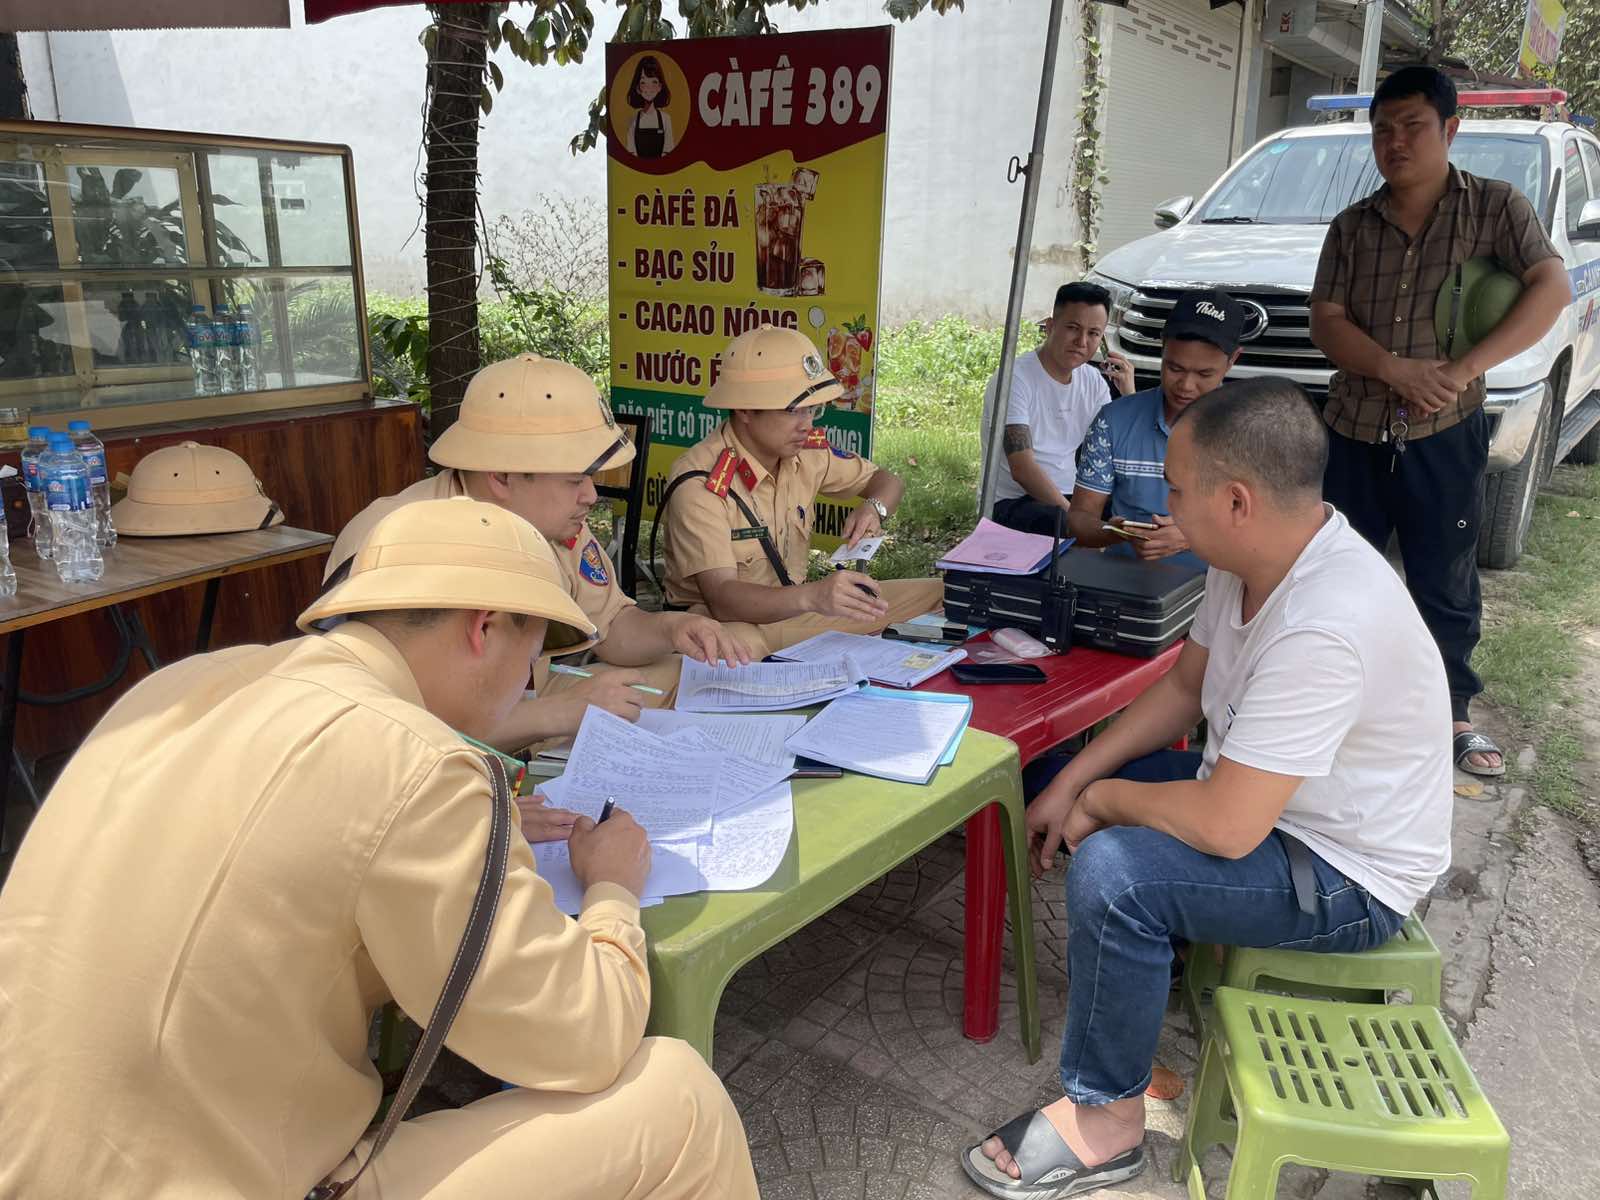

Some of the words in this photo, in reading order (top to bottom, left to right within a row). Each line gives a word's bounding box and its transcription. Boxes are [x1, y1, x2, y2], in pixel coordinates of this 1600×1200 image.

[698, 54, 795, 127] CÀFÊ
[805, 64, 882, 126] 389
[634, 188, 695, 226] CÀFÊ
[704, 189, 739, 227] ĐÁ
[635, 248, 683, 286] BẠC
[692, 241, 735, 282] SỈU
[635, 301, 715, 335] CACAO
[635, 350, 701, 386] NƯỚC
[710, 353, 722, 387] É
[678, 406, 695, 438] CÓ
[813, 502, 854, 537] HAN
